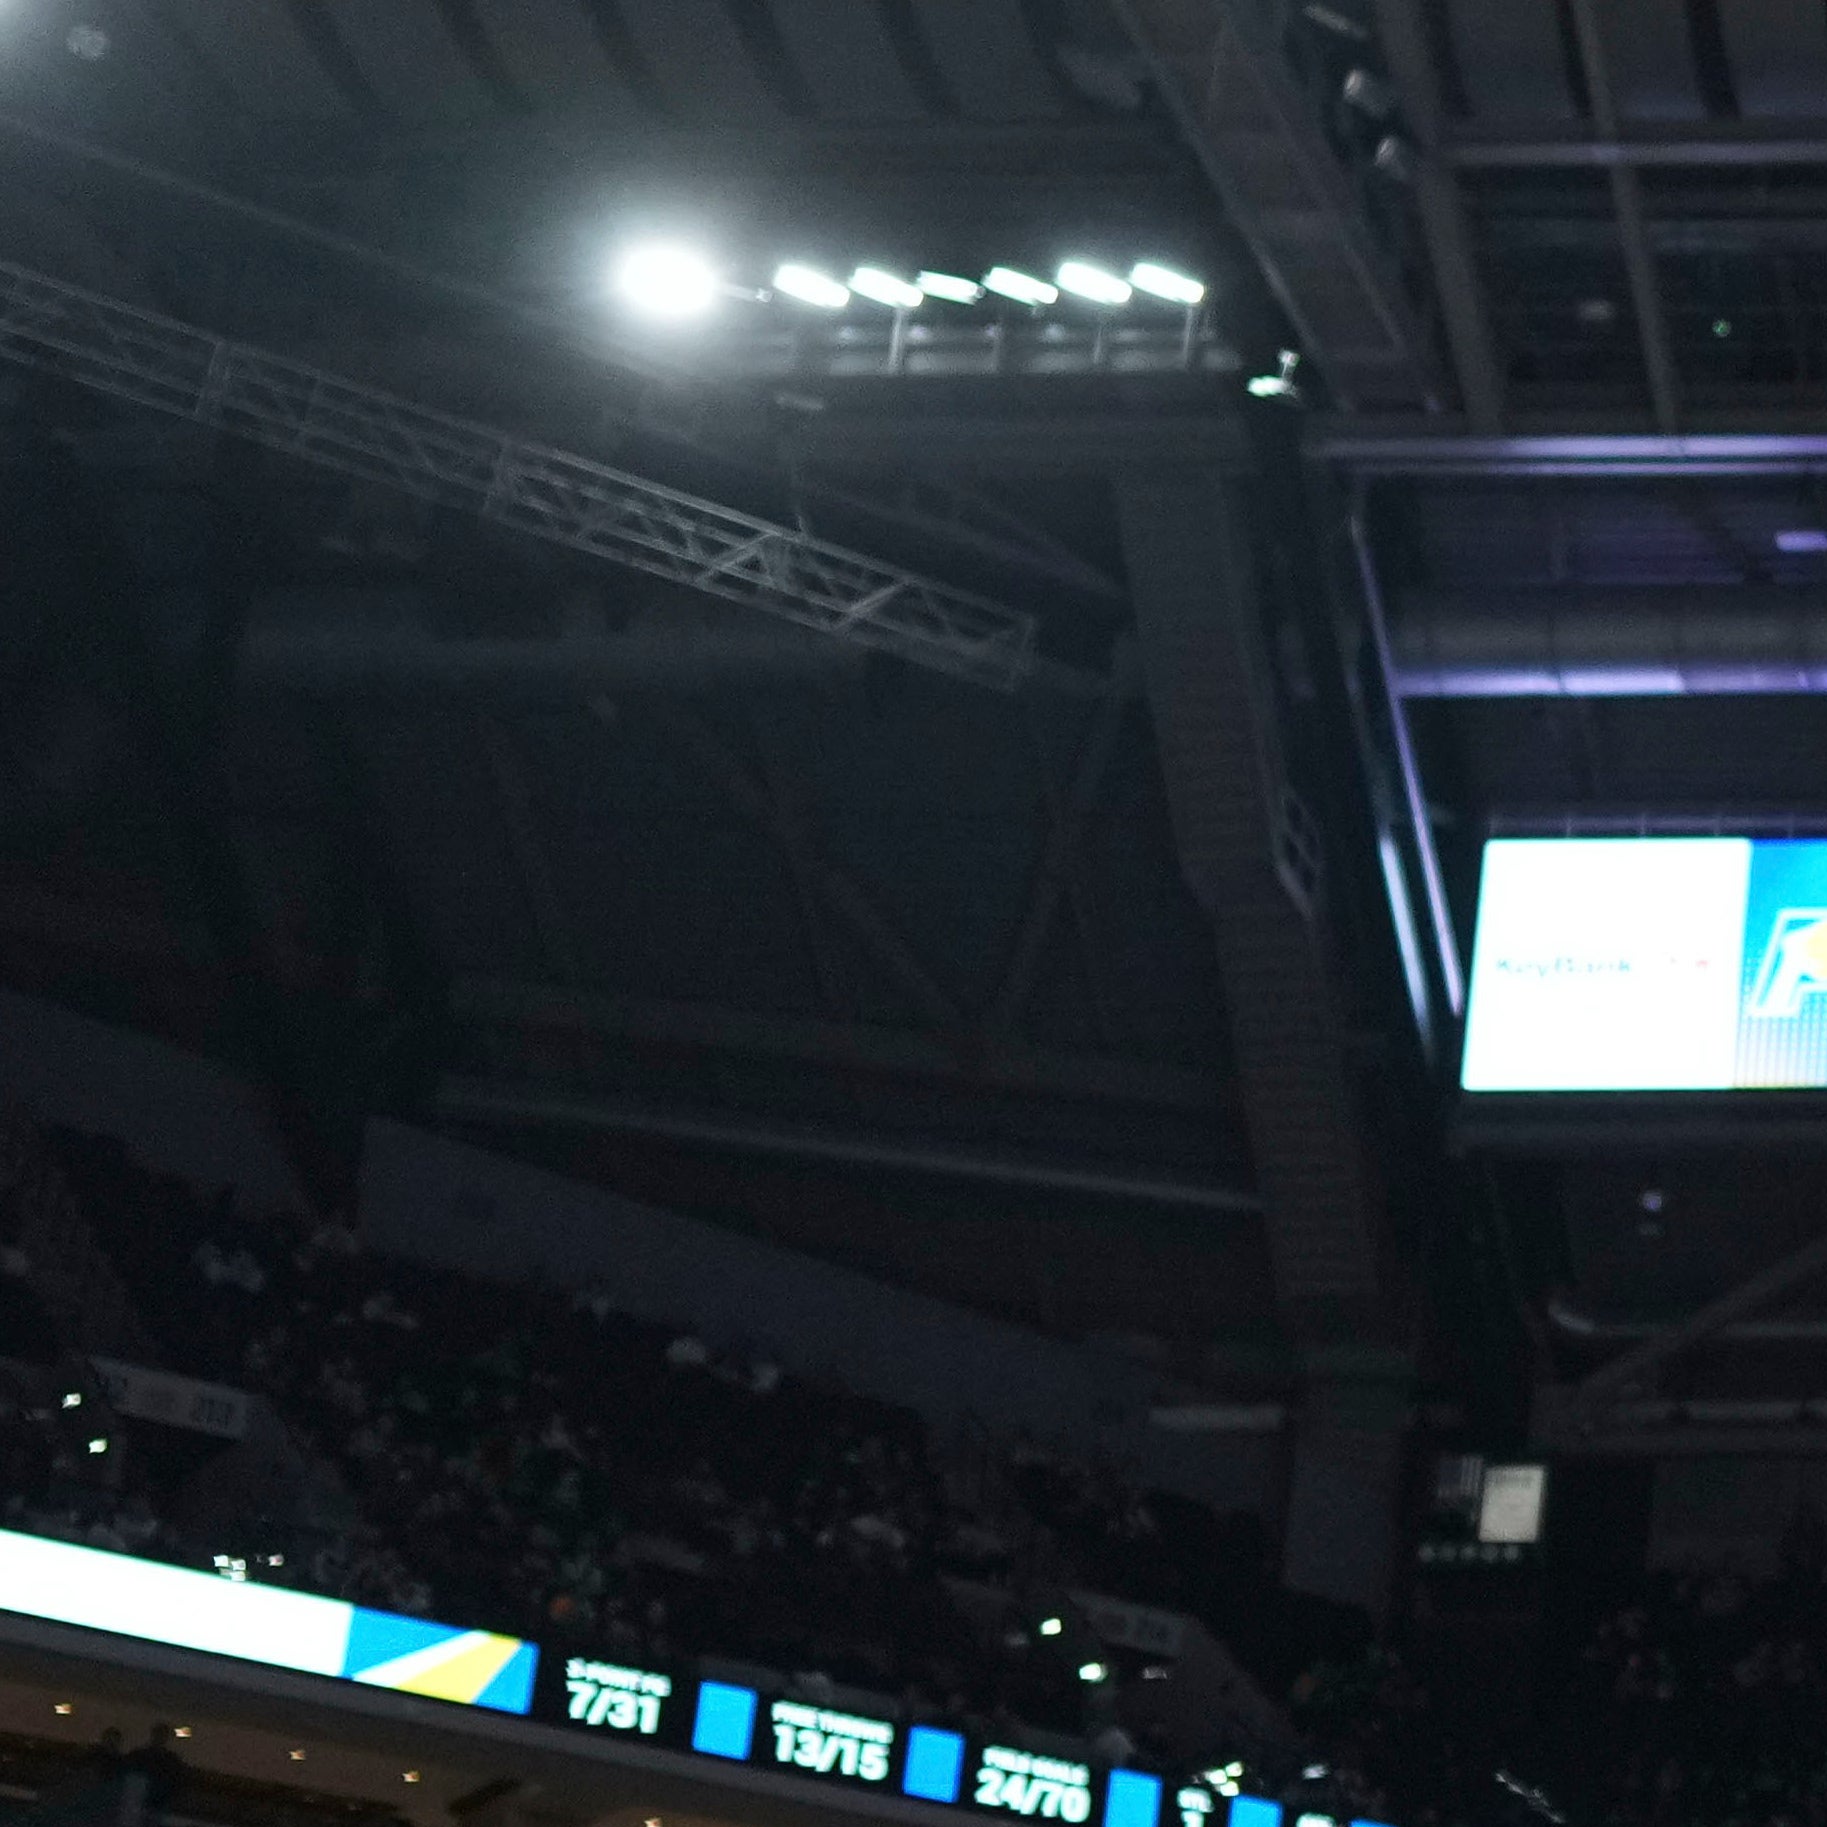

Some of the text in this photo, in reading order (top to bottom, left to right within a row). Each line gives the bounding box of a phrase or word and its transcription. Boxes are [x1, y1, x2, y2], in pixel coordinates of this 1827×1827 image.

[566, 1680, 662, 1735] 7/31
[774, 1722, 889, 1782] 13/15
[975, 1768, 1091, 1824] 24/70
